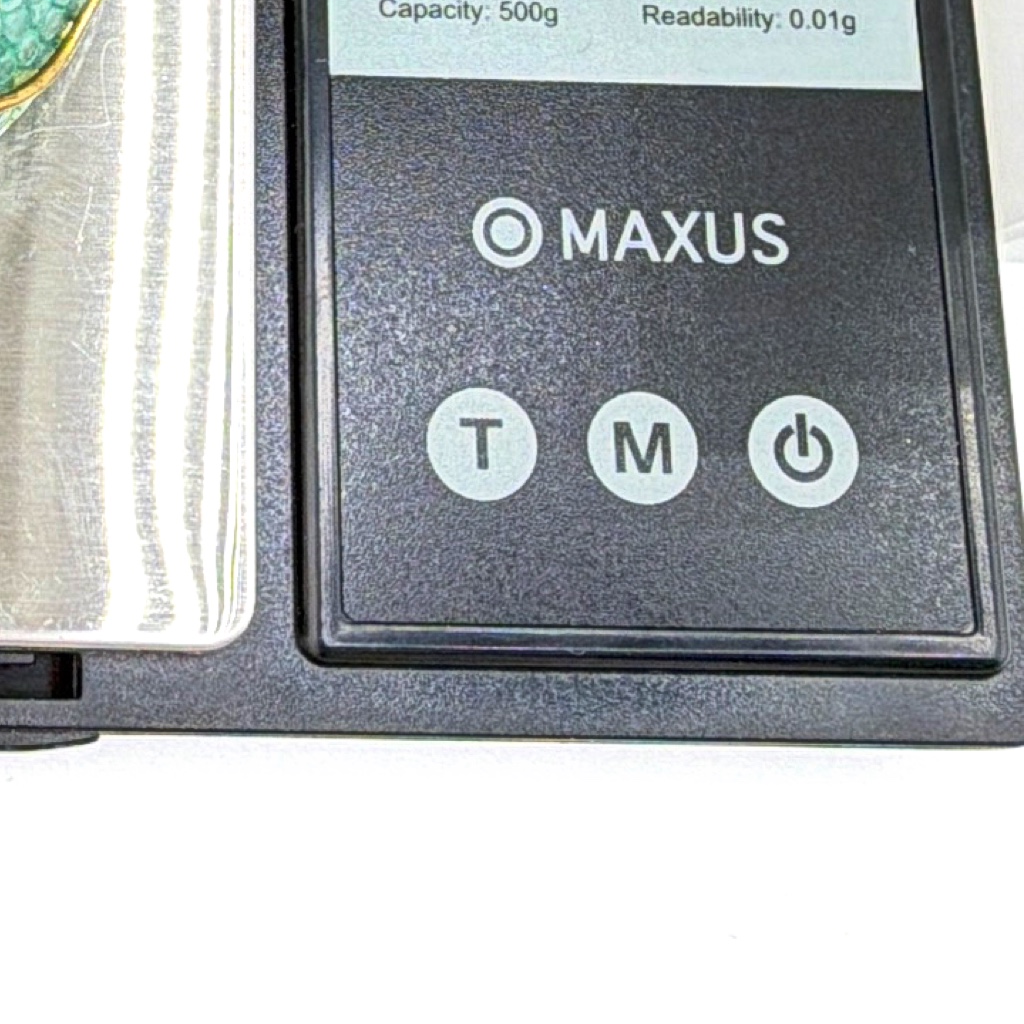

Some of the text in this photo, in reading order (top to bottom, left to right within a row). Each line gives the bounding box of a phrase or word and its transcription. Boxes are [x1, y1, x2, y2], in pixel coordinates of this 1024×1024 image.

[498, 0, 559, 27] 500g
[642, 4, 856, 35] Readability: 0.01g
[561, 208, 790, 265] MAXUS
[459, 418, 504, 470] T
[613, 421, 673, 474] M
